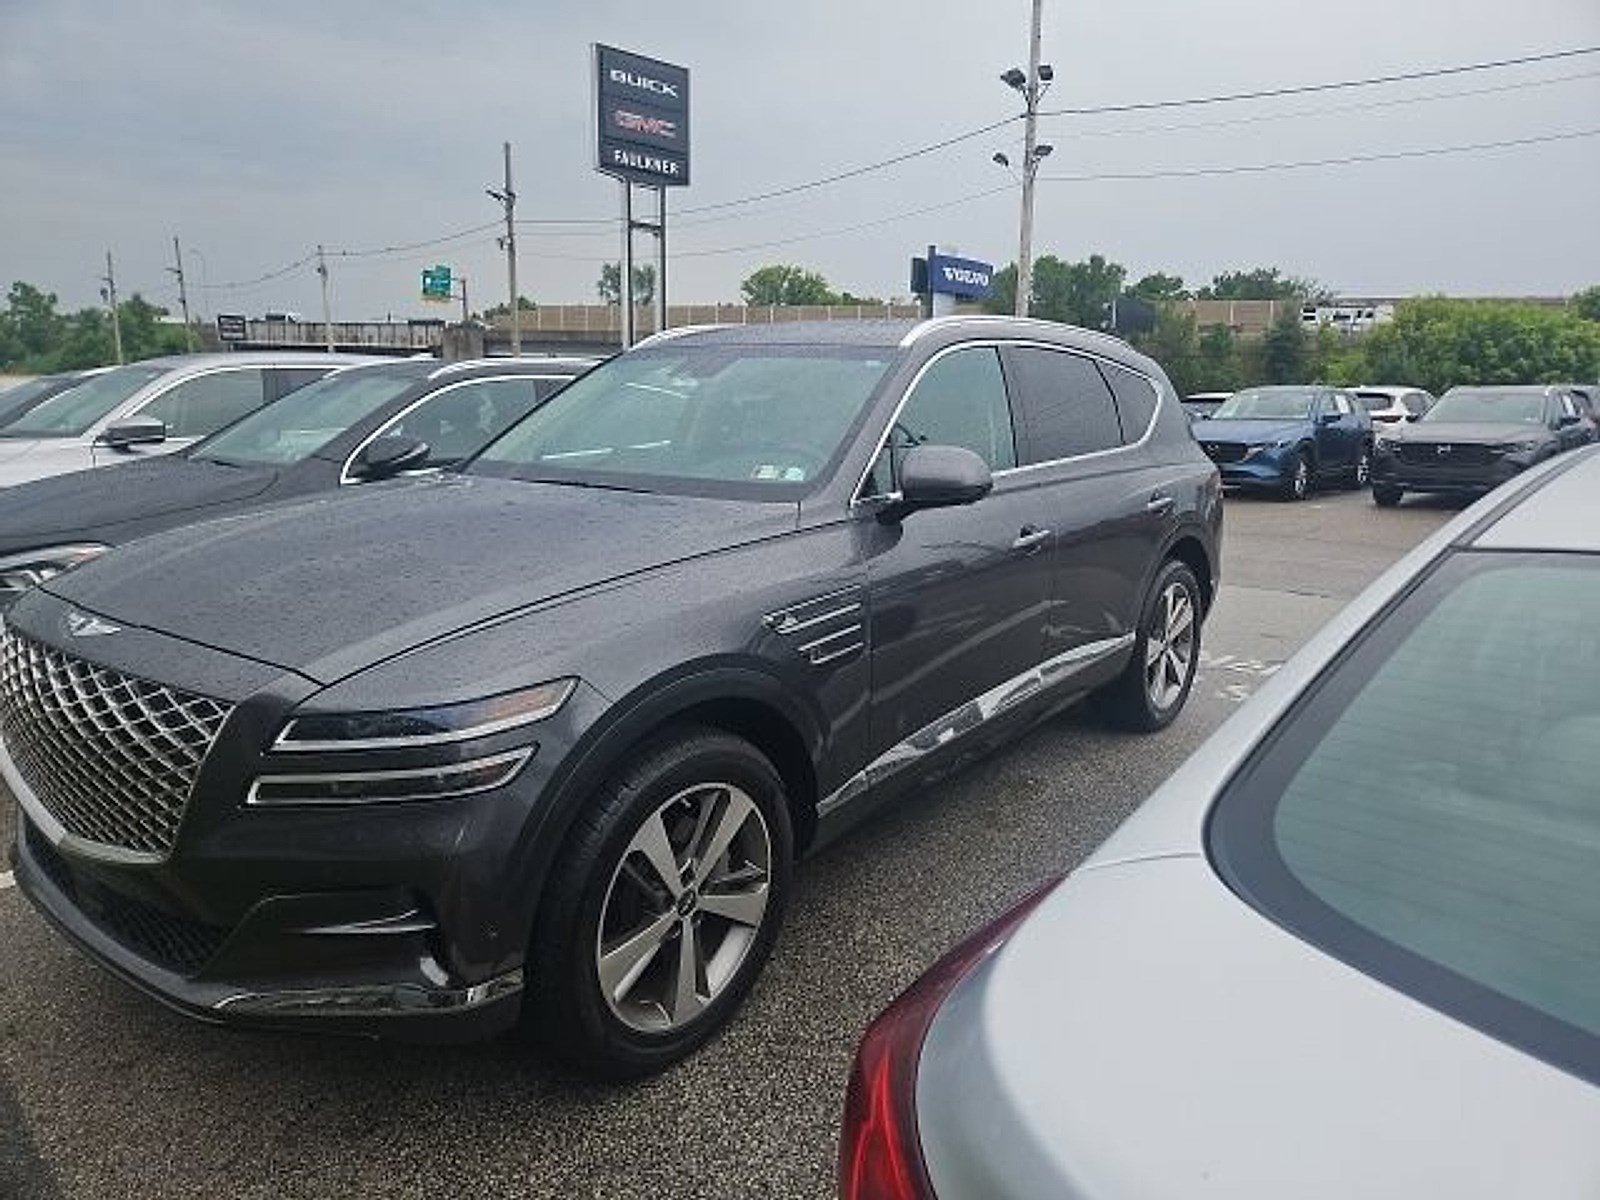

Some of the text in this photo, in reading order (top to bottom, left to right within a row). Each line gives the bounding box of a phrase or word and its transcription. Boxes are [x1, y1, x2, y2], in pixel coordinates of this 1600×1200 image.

[610, 69, 679, 98] BUICK
[615, 109, 676, 138] GMC
[614, 149, 679, 177] FAULKNER
